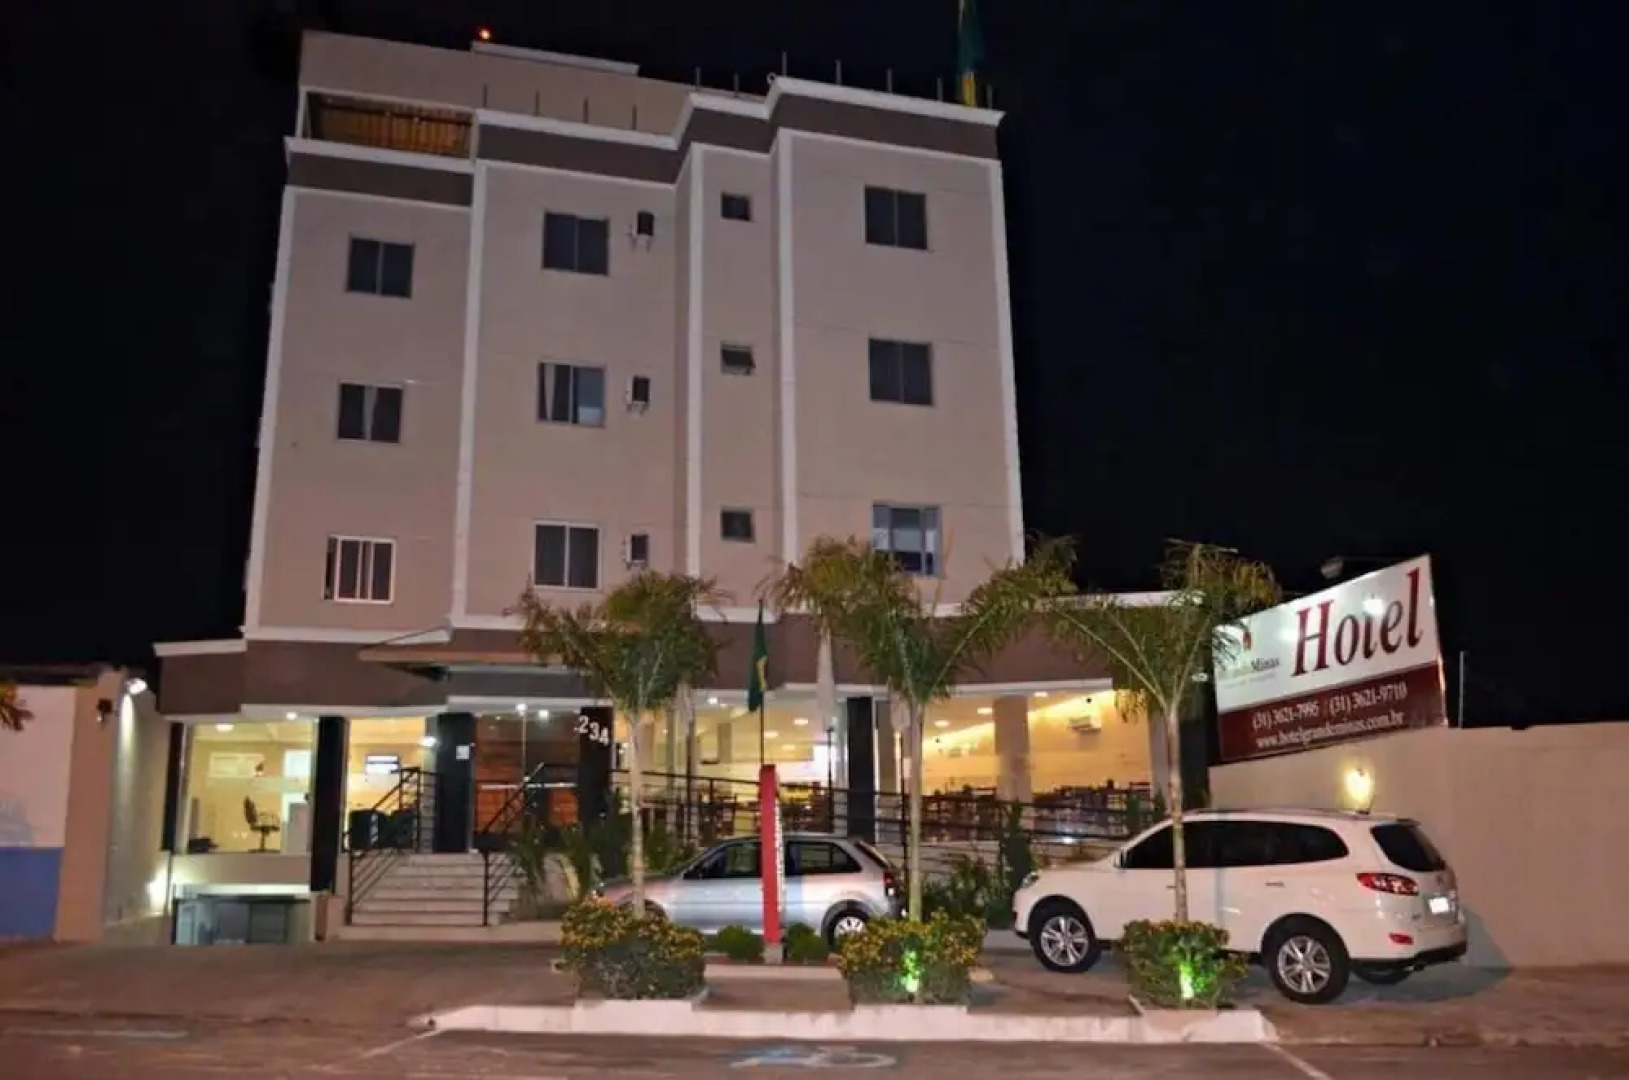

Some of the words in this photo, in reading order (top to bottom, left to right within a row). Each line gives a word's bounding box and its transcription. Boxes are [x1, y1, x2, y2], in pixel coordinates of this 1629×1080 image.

[1291, 567, 1423, 676] Hotel
[1329, 695, 1351, 715] (31)
[578, 715, 609, 746] 234
